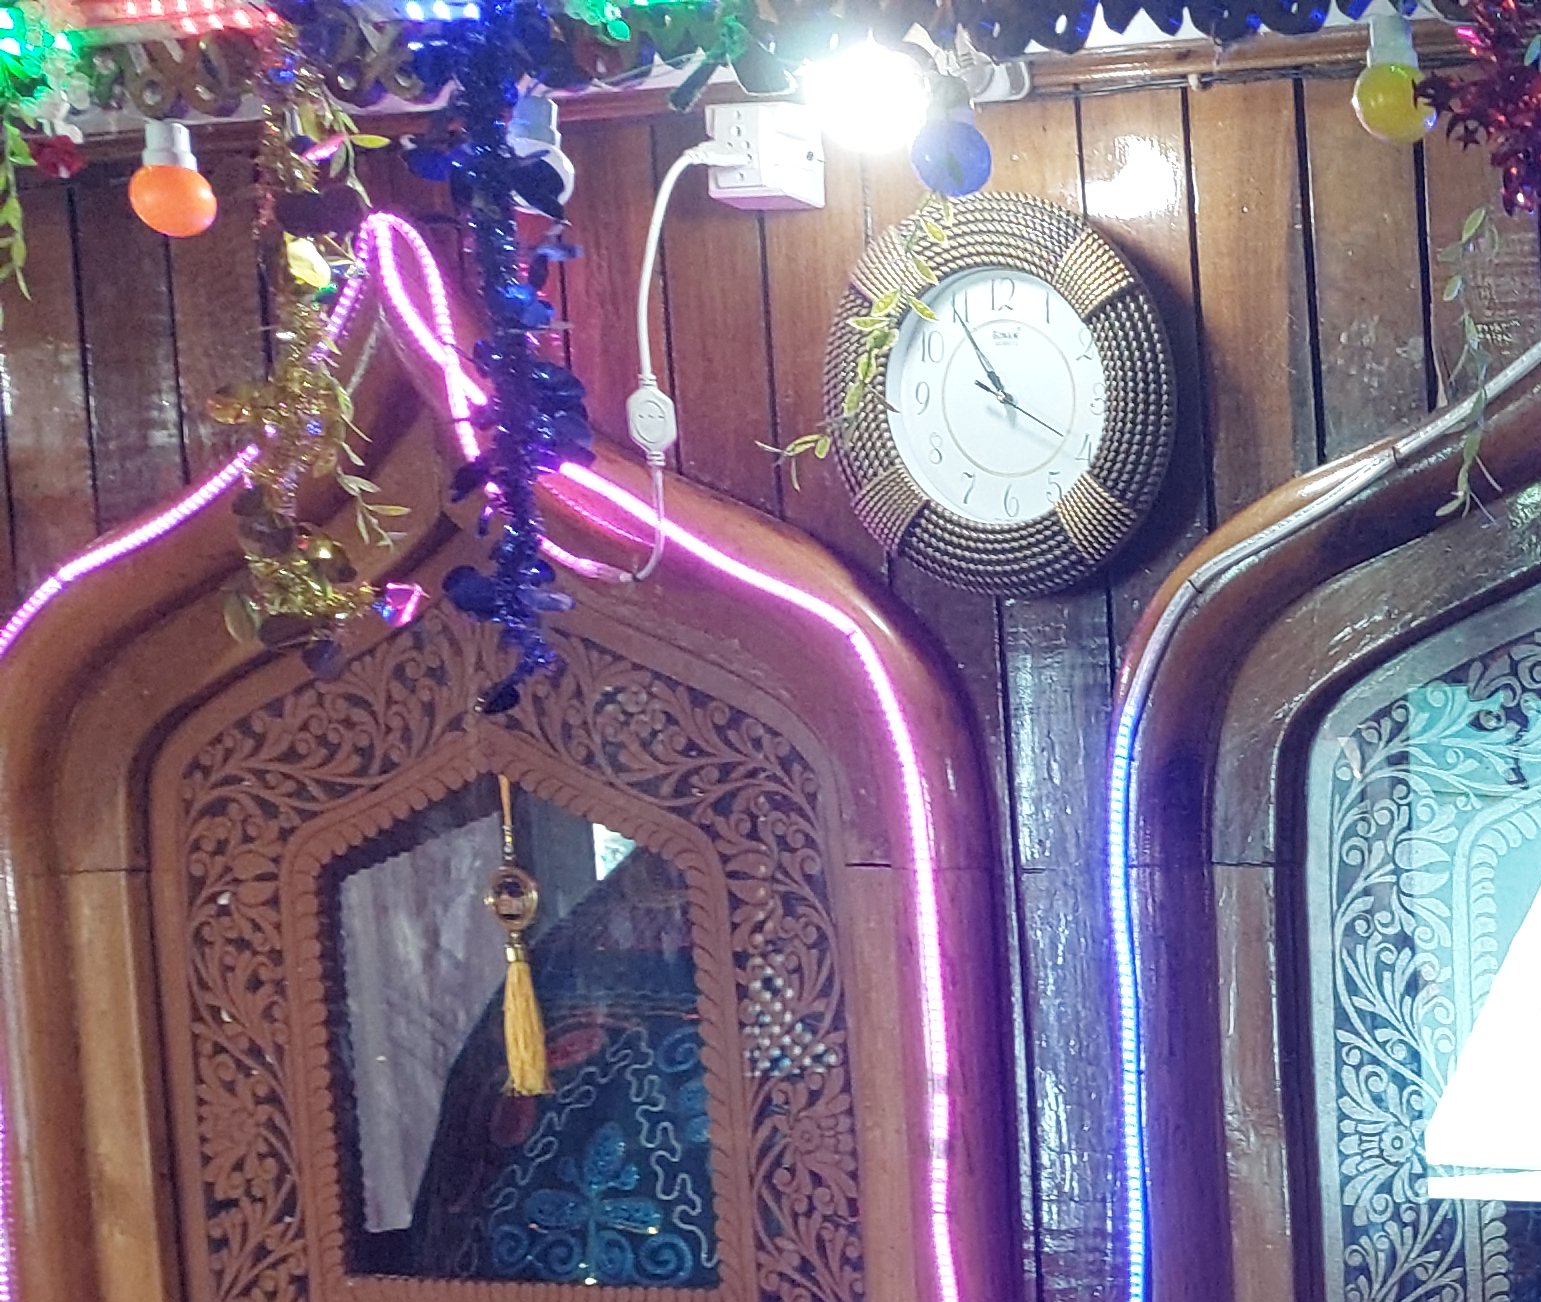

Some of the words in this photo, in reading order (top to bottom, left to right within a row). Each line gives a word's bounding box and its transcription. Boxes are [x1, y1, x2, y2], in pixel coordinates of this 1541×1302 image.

[952, 289, 969, 323] 11
[991, 278, 1015, 311] 12
[1045, 291, 1051, 325] 1
[921, 330, 945, 363] 10
[1076, 327, 1093, 361] 2
[915, 381, 930, 415] 9
[1090, 382, 1106, 416] 3
[929, 432, 943, 465] 8
[1075, 433, 1092, 464] 4
[961, 471, 976, 505] 7
[1004, 484, 1020, 518] 6
[1046, 471, 1062, 503] 5
